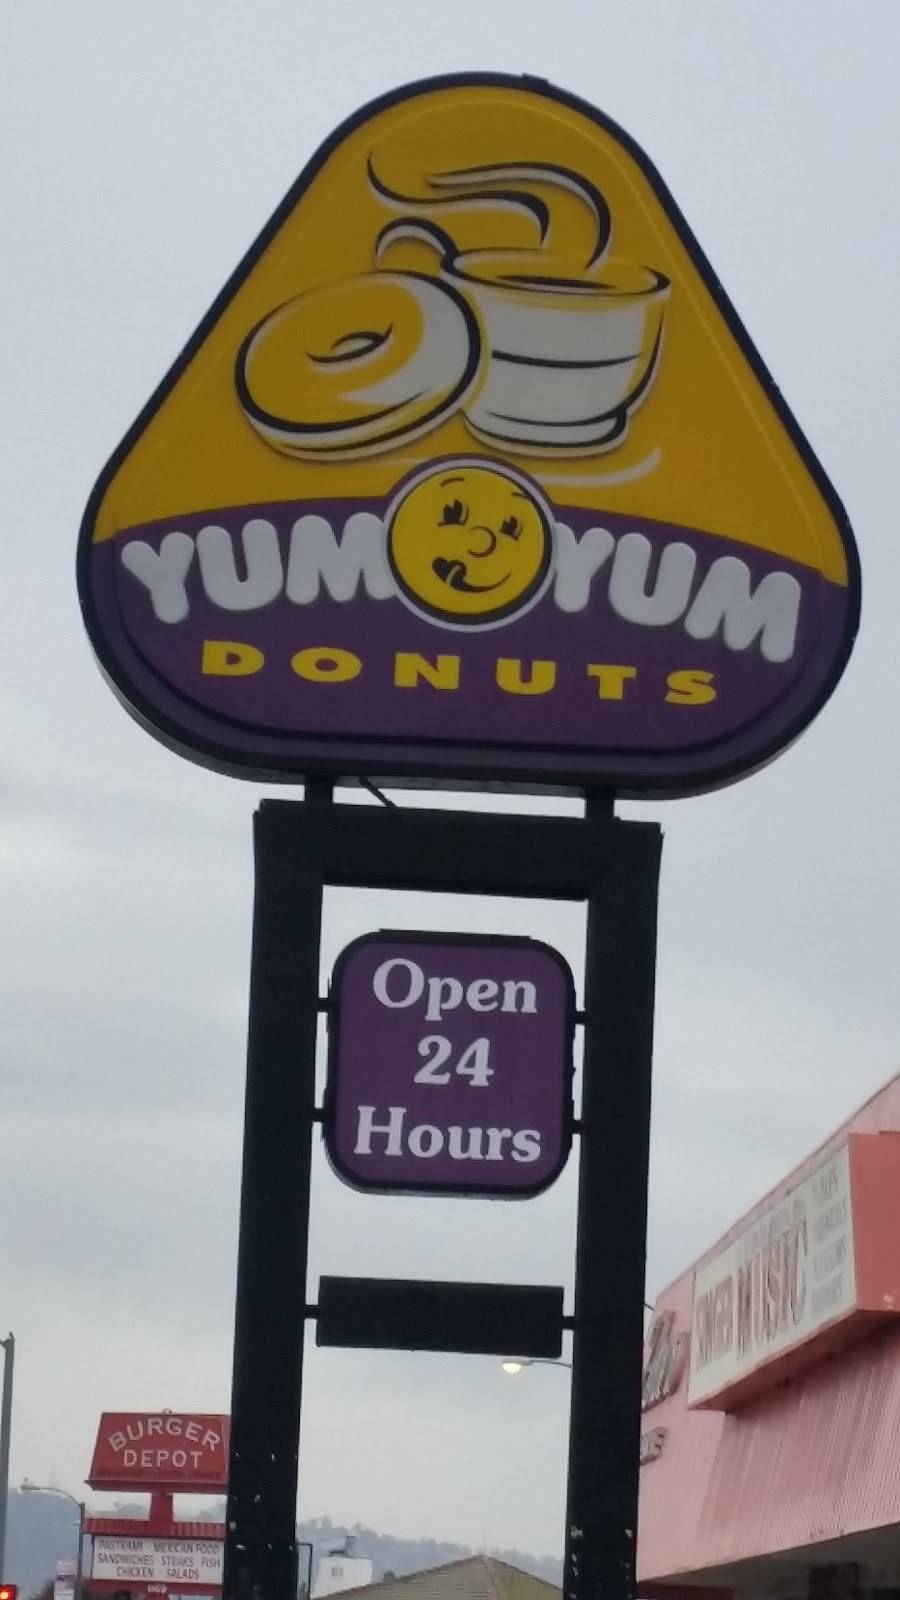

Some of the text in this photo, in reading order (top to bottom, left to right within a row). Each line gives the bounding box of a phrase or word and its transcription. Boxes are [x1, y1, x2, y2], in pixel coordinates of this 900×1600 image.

[120, 512, 801, 663] YUM YUM
[202, 641, 717, 705] DONUTS
[373, 958, 538, 1021] Open
[414, 1035, 494, 1087] 24
[353, 1106, 541, 1162] Hours
[108, 1418, 220, 1452] BURGER
[123, 1449, 203, 1469] DEPOT
[96, 1553, 221, 1568] SANDWICHES STEAKS FISH
[153, 1541, 193, 1553] MEXICAN
[195, 1543, 220, 1555] FOOD
[116, 1566, 200, 1579] CHICKEN SALADS
